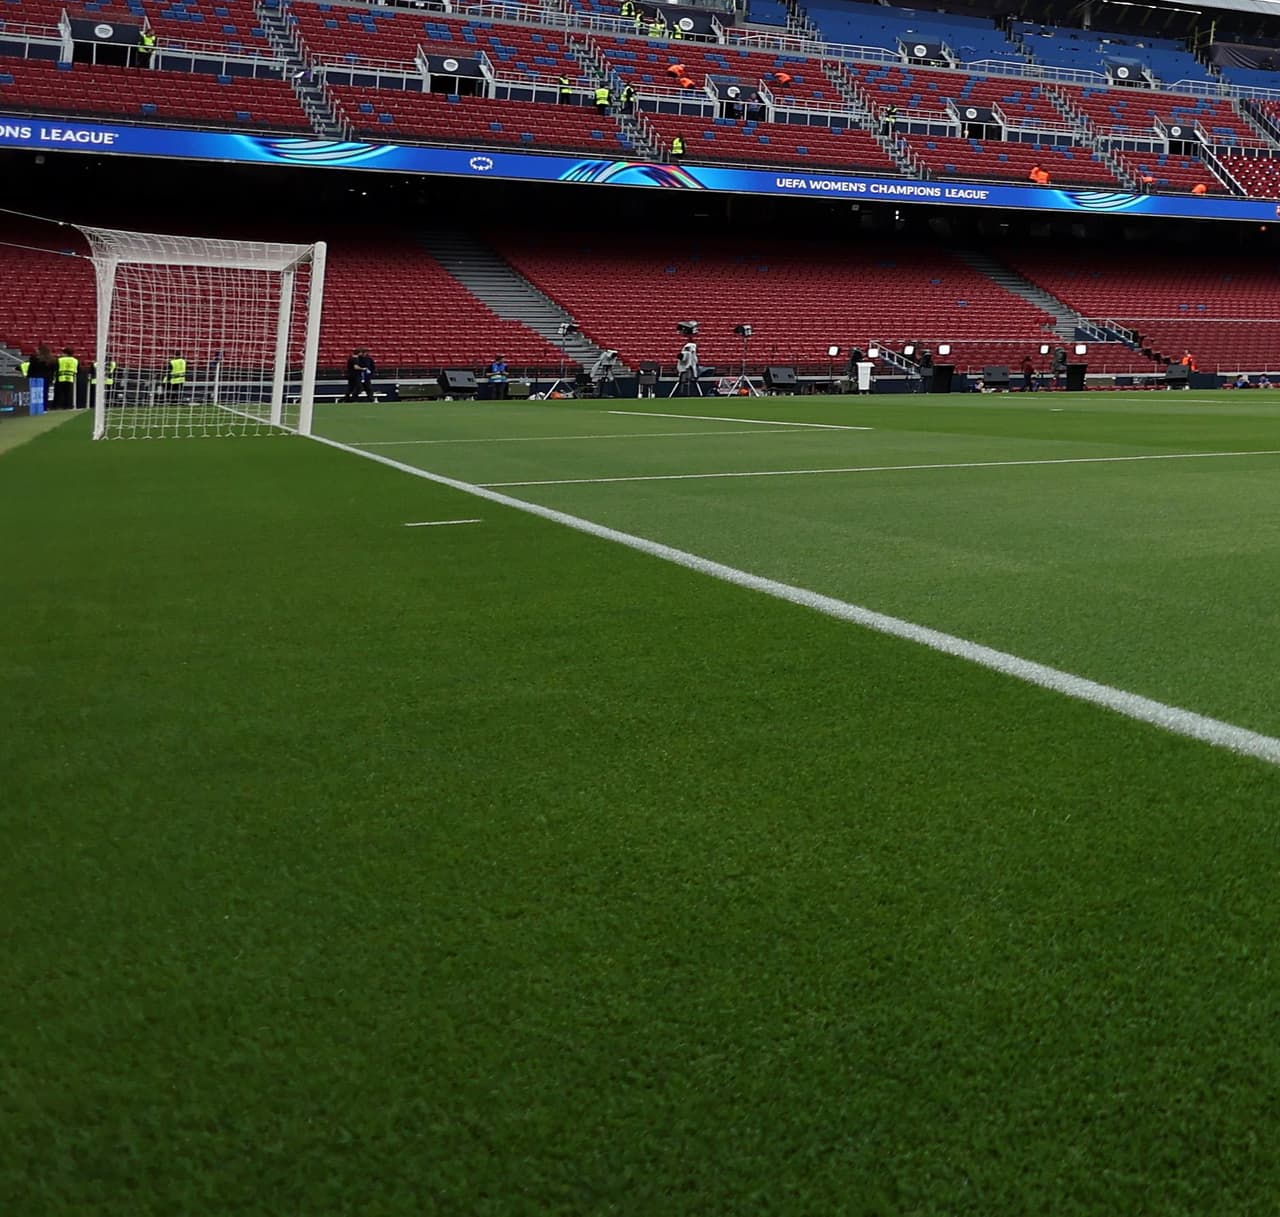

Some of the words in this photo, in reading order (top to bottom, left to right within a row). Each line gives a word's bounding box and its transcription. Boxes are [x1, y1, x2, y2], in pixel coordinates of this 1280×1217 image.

[776, 178, 806, 189] UEFA
[809, 179, 866, 193] WOMEN'S
[870, 183, 941, 197] CHAMPIONS
